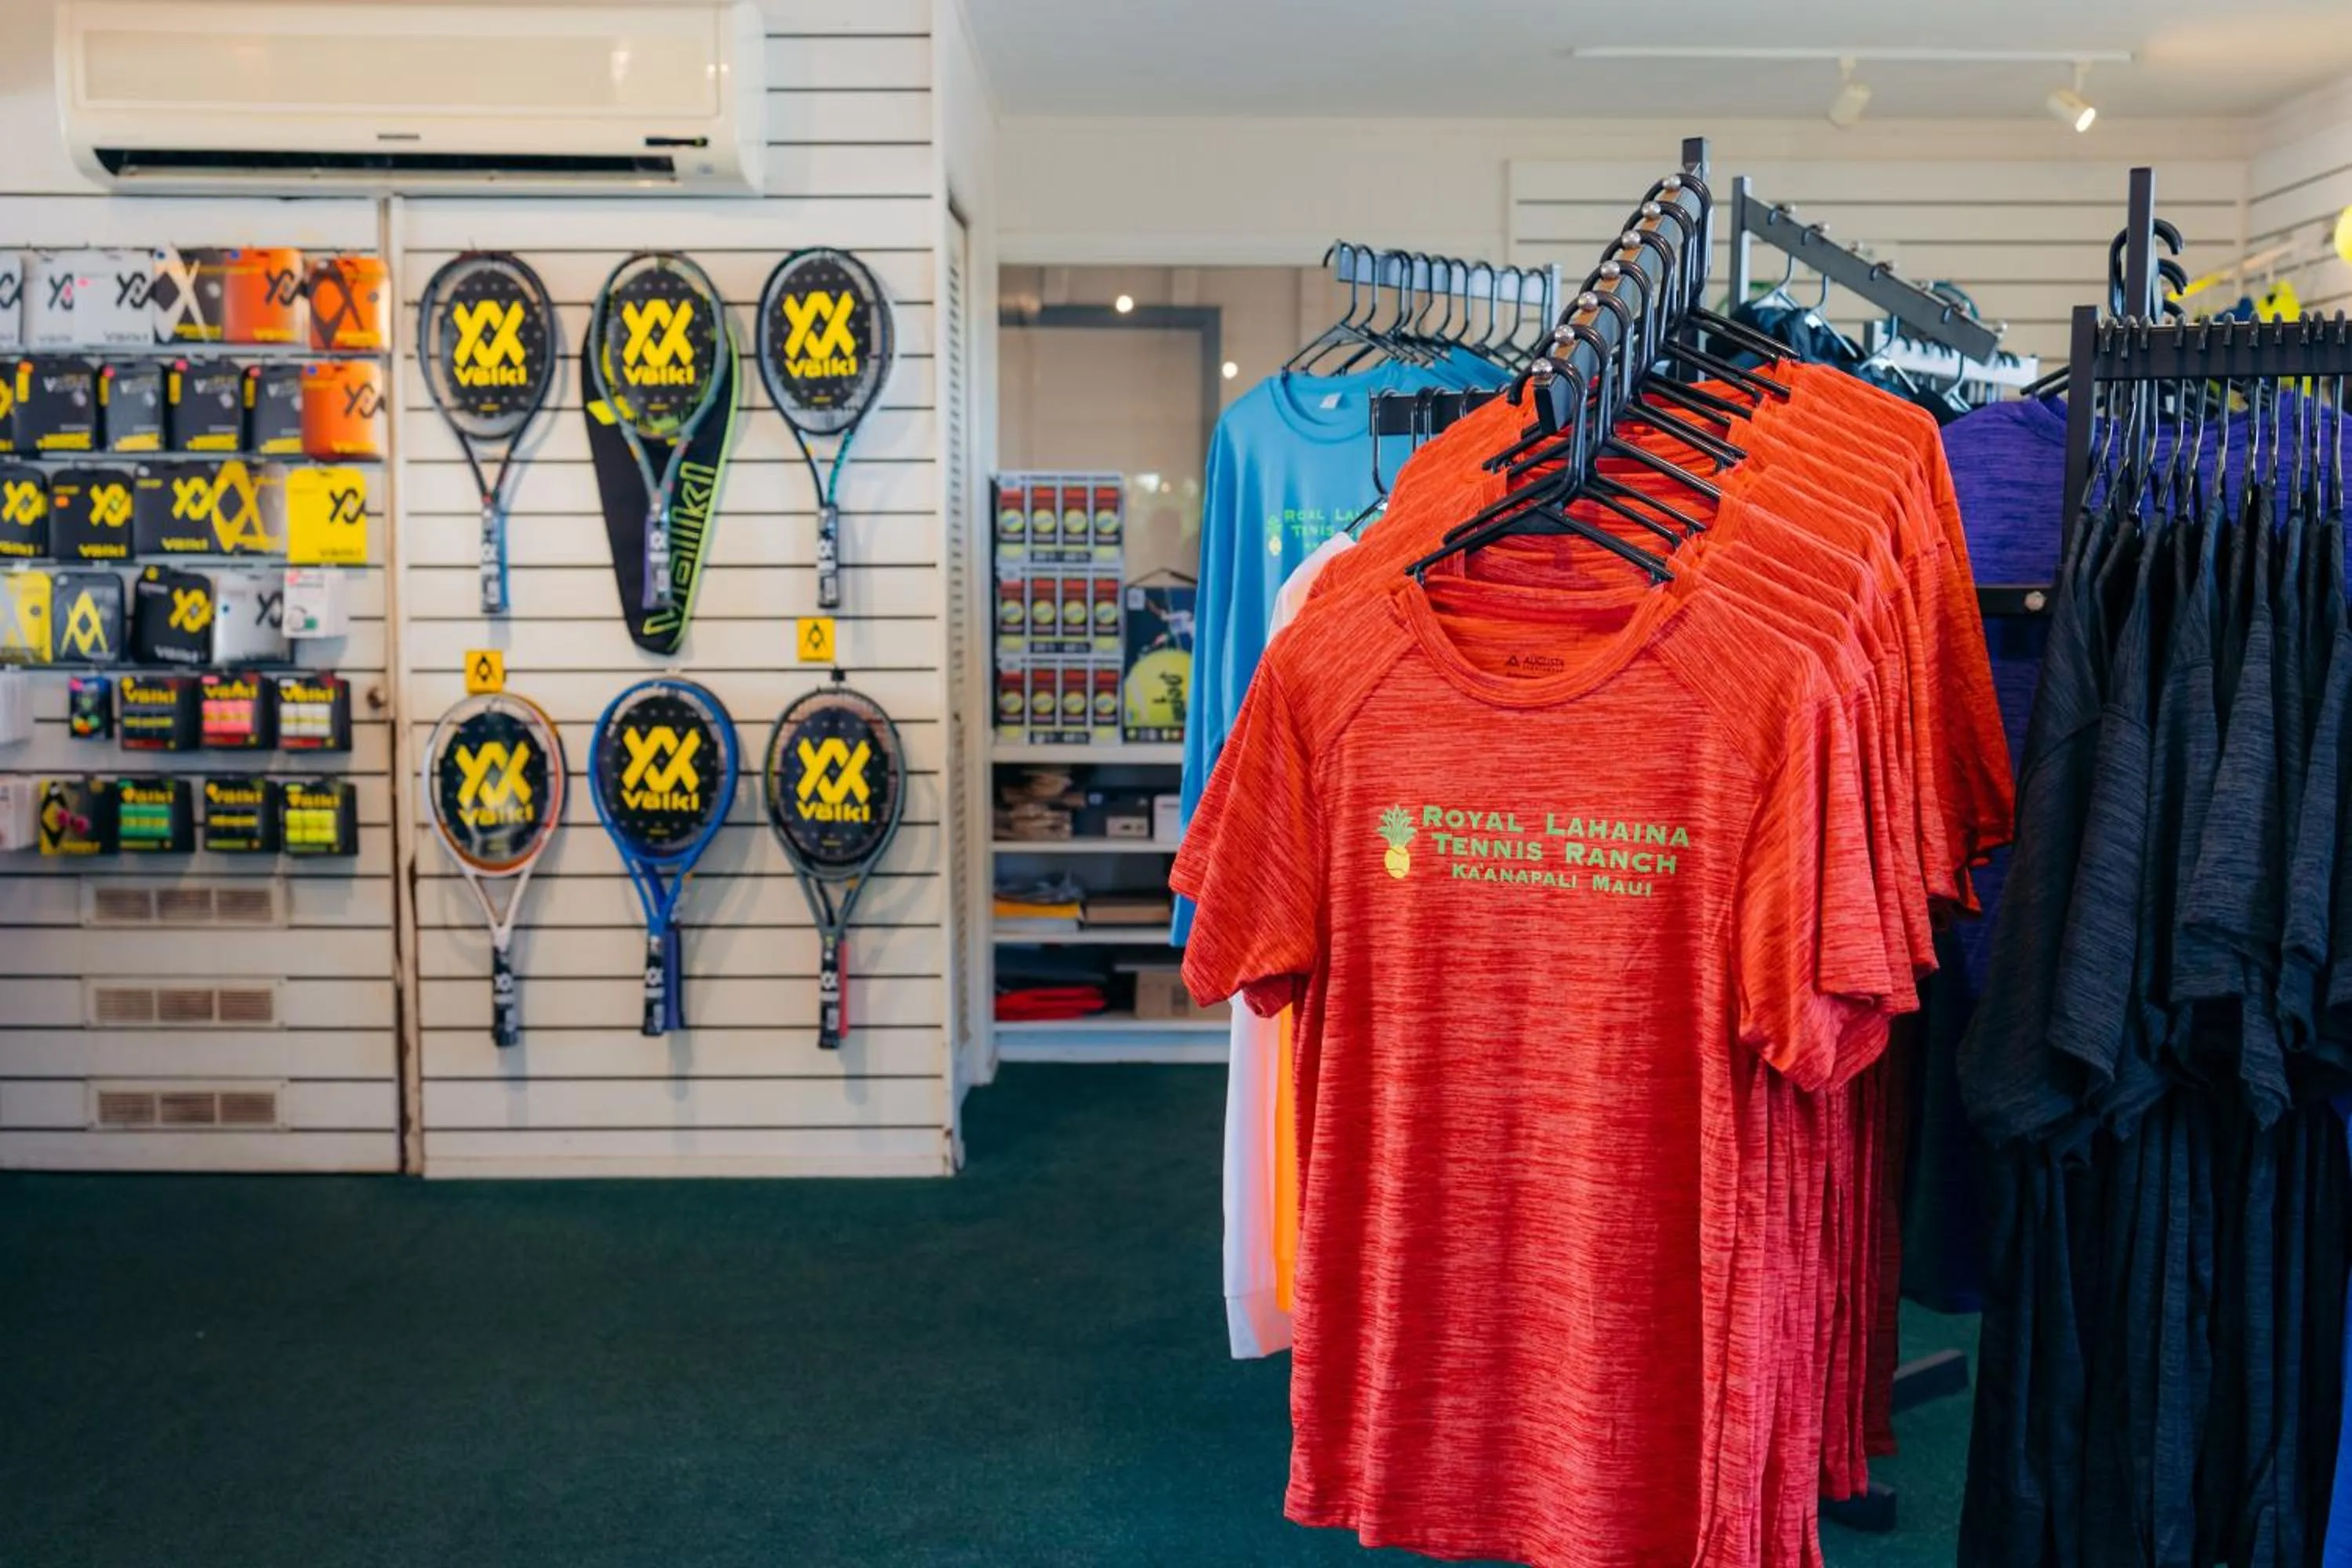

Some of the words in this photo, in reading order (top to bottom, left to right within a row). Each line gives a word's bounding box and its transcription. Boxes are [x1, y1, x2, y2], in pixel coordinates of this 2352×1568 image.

[1422, 804, 1525, 833] ROYAL
[1546, 812, 1690, 848] LAHAINA
[1431, 833, 1543, 861] TENNIS
[1566, 841, 1677, 875] RANCH
[1592, 873, 1653, 898] MAUI
